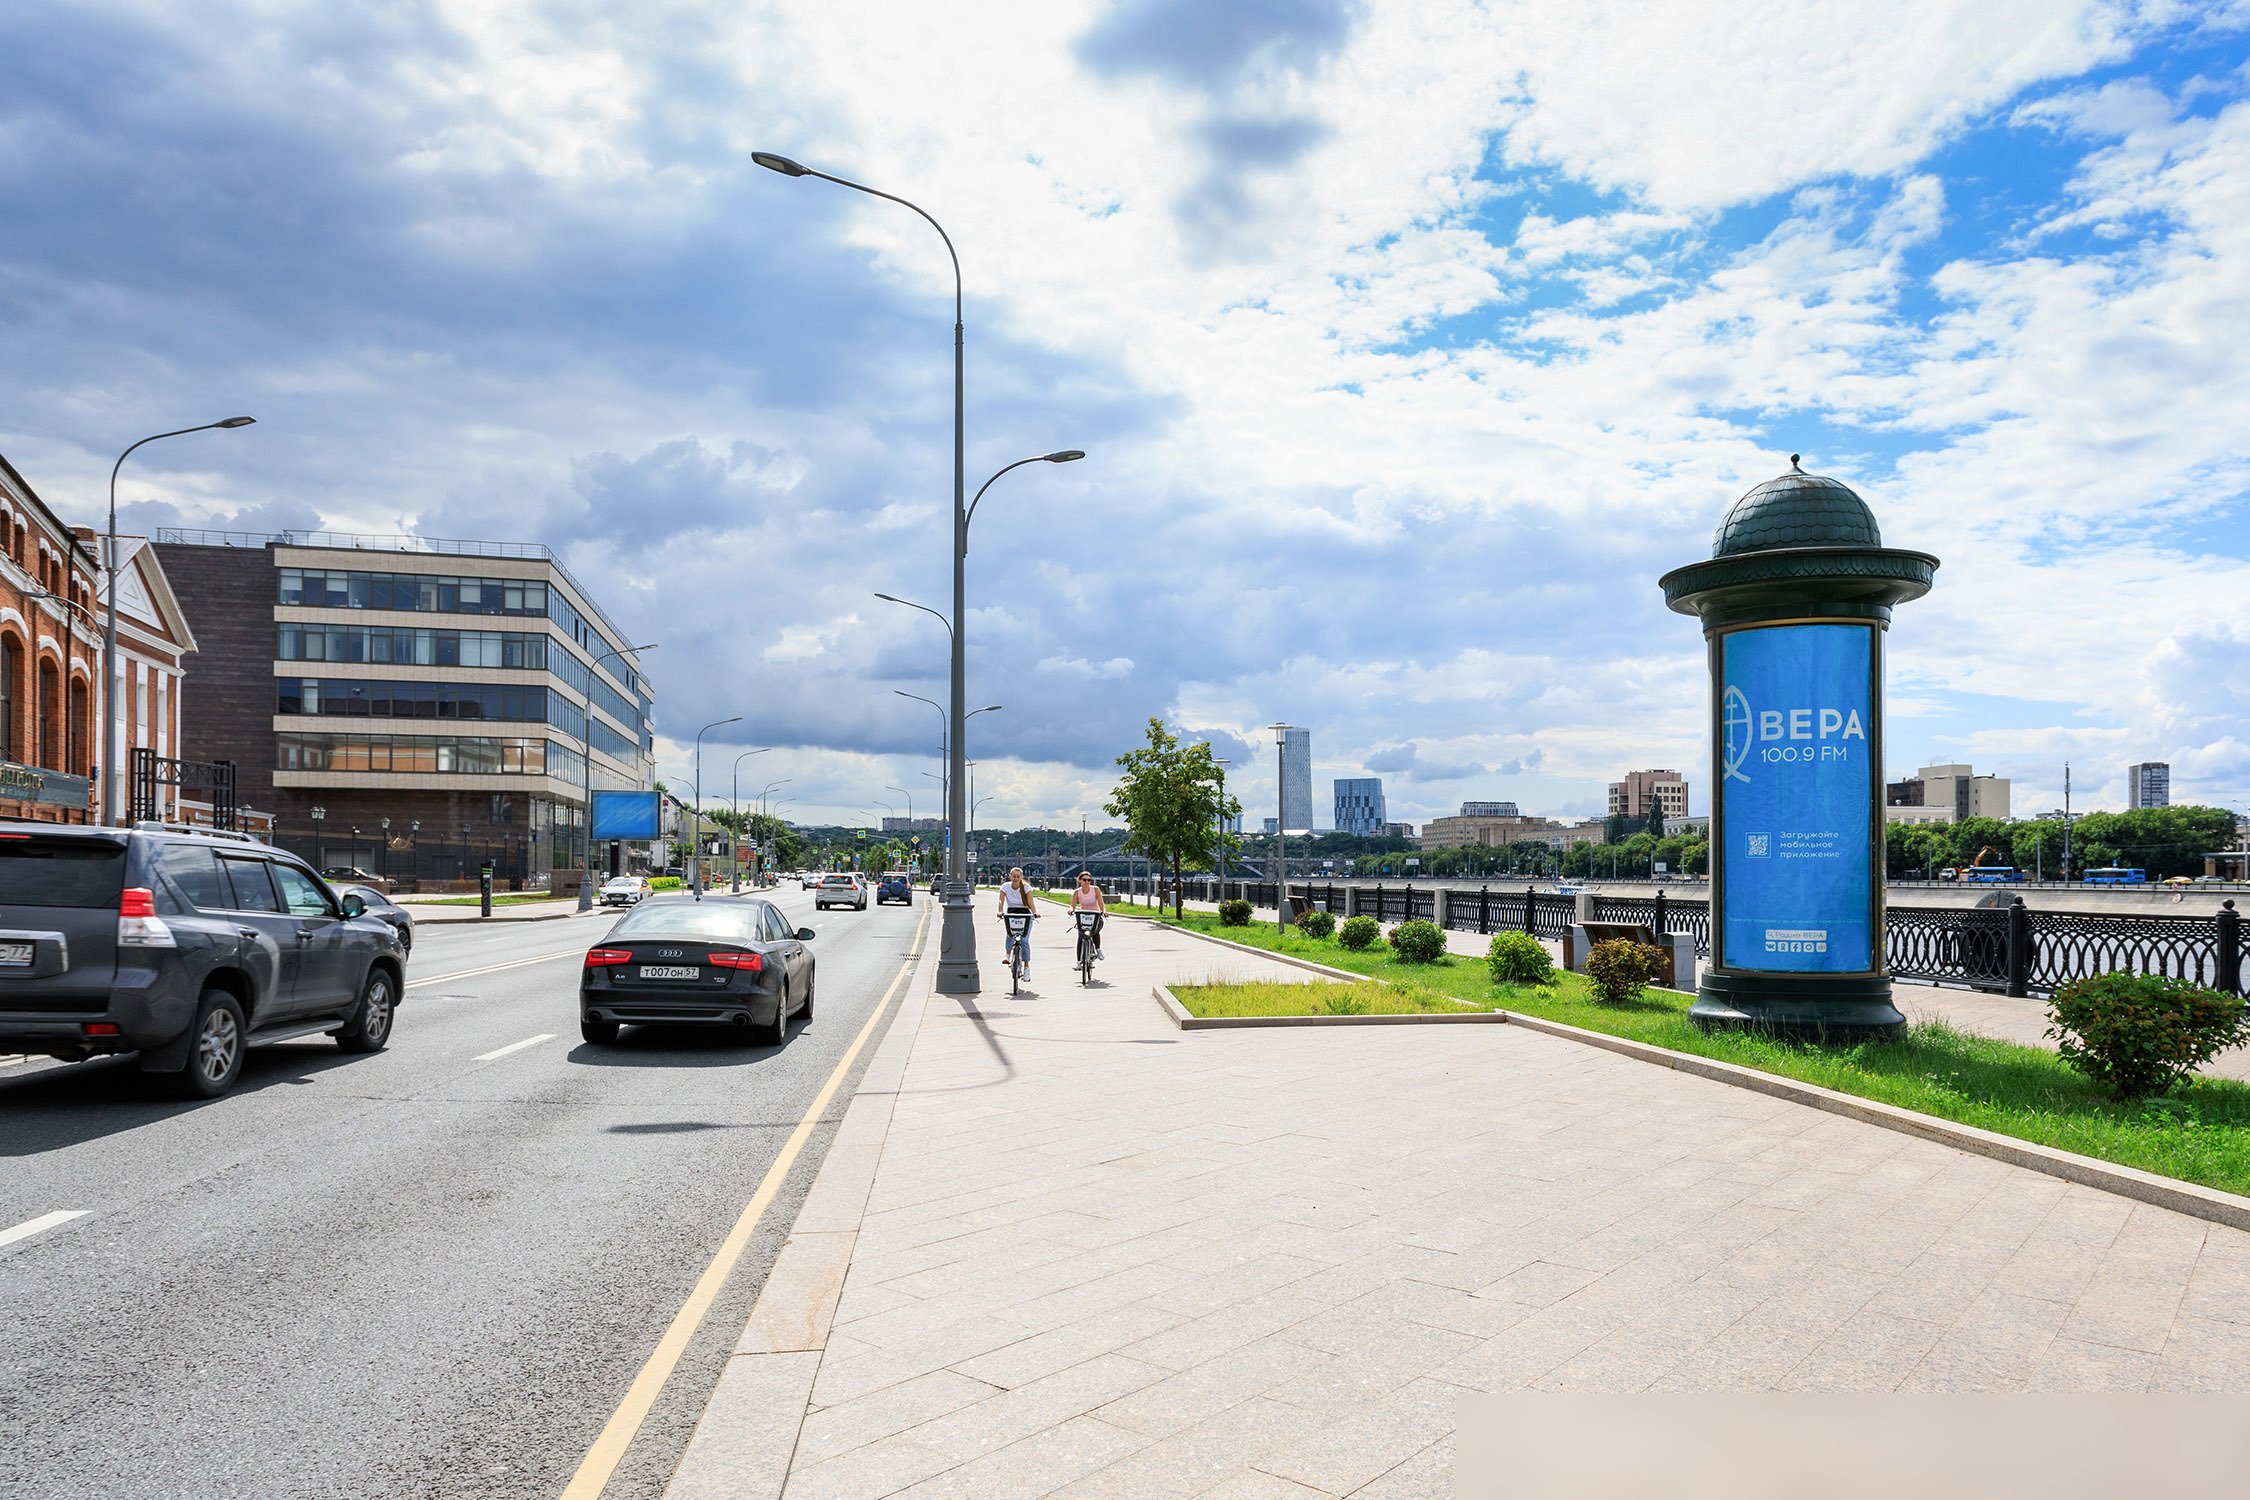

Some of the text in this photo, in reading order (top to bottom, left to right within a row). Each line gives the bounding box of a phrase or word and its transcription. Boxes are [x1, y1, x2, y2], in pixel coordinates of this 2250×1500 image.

[1760, 708, 1865, 741] ВЕРА
[1761, 746, 1847, 763] 100.9 FM
[1780, 831, 1839, 840] Загружайте
[1780, 840, 1833, 848] мобильное
[1780, 851, 1840, 859] приложение
[1775, 931, 1801, 939] Радио
